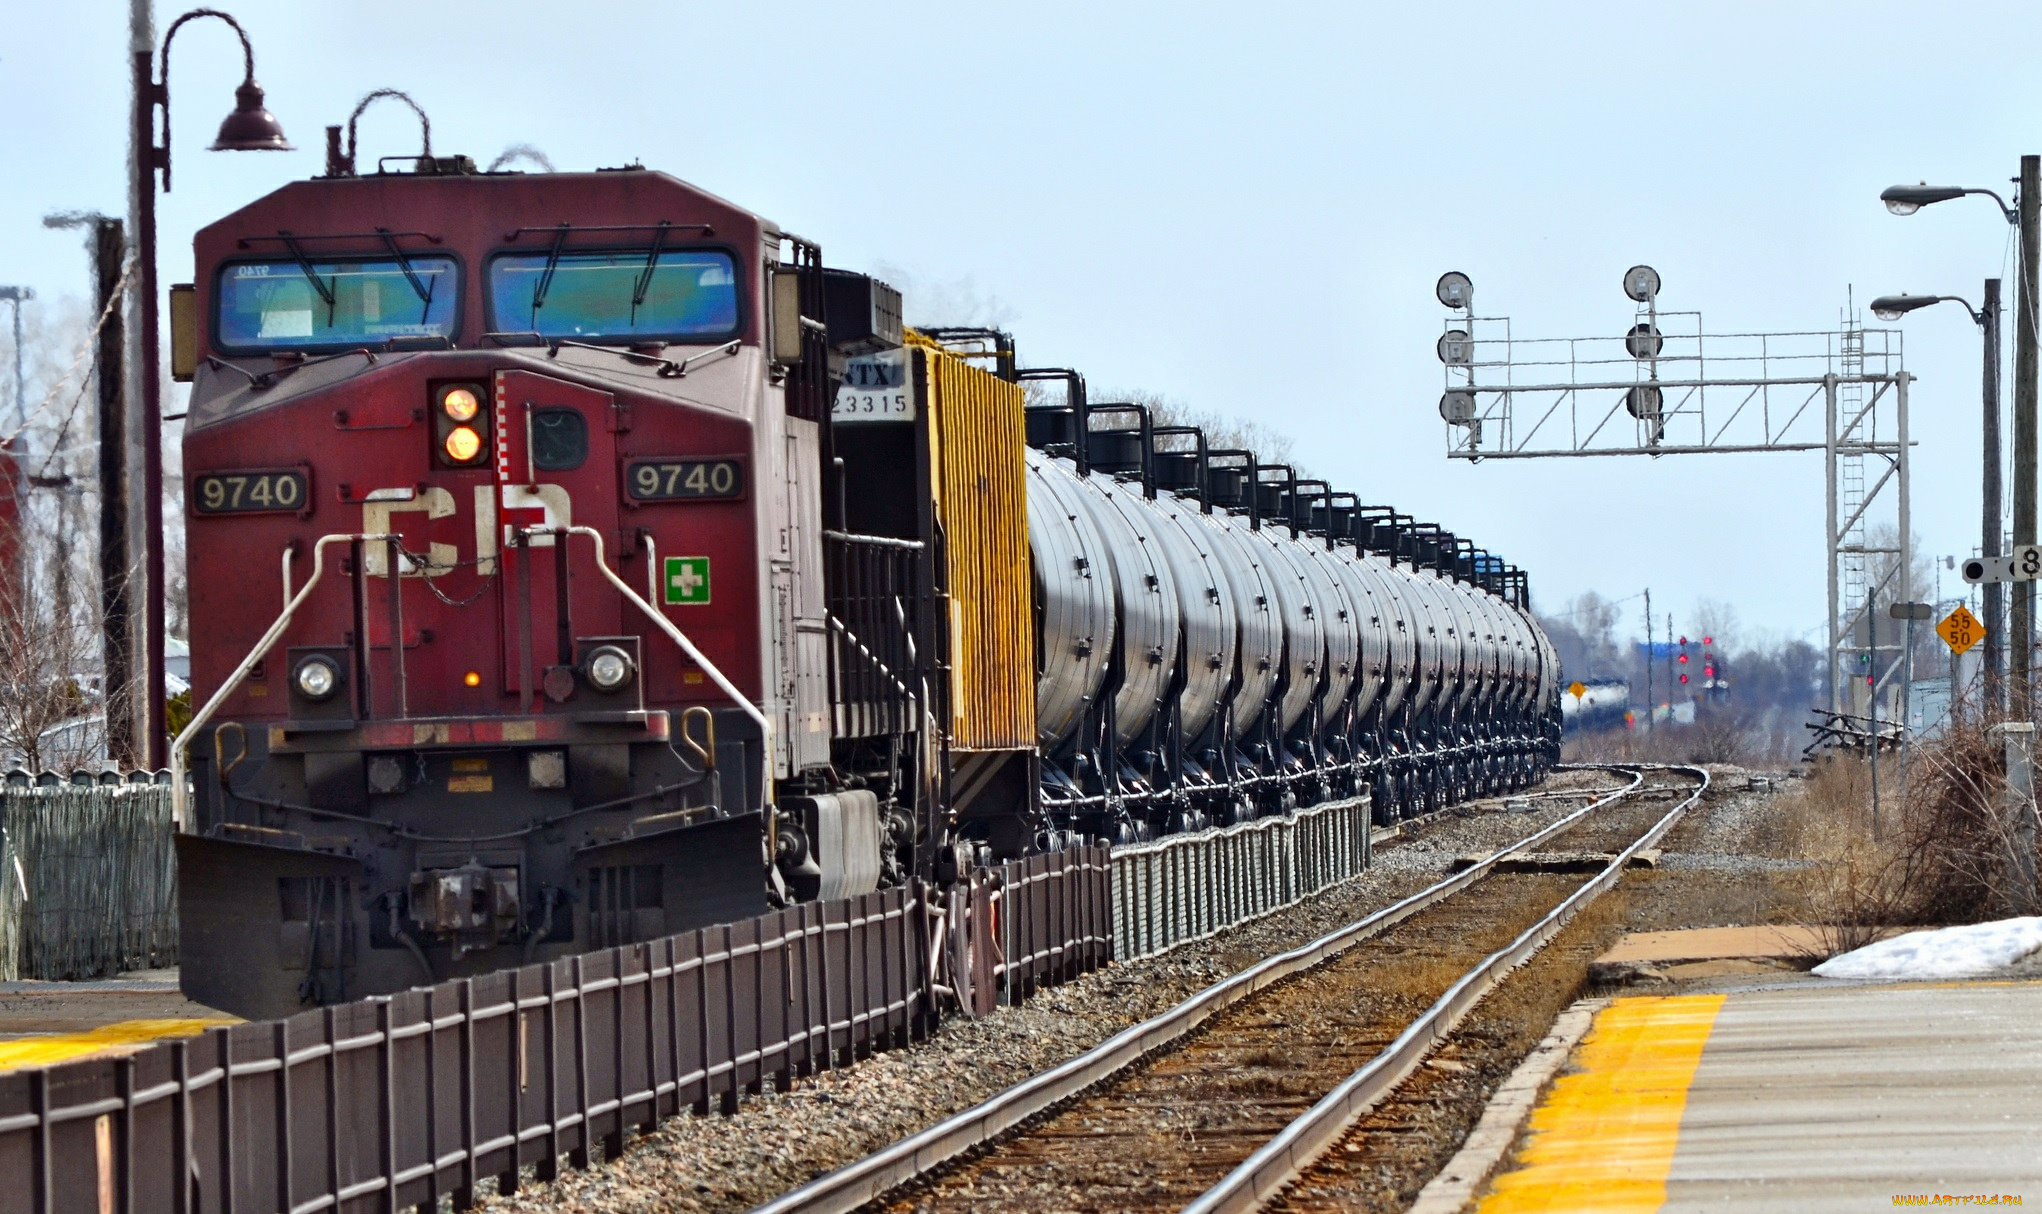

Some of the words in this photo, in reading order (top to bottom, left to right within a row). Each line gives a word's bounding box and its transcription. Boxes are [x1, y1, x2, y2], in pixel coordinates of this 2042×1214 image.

[204, 476, 297, 508] 9740
[637, 463, 733, 495] 9740
[363, 484, 571, 578] CP
[1950, 614, 1970, 629] 55
[1950, 631, 1970, 645] 50
